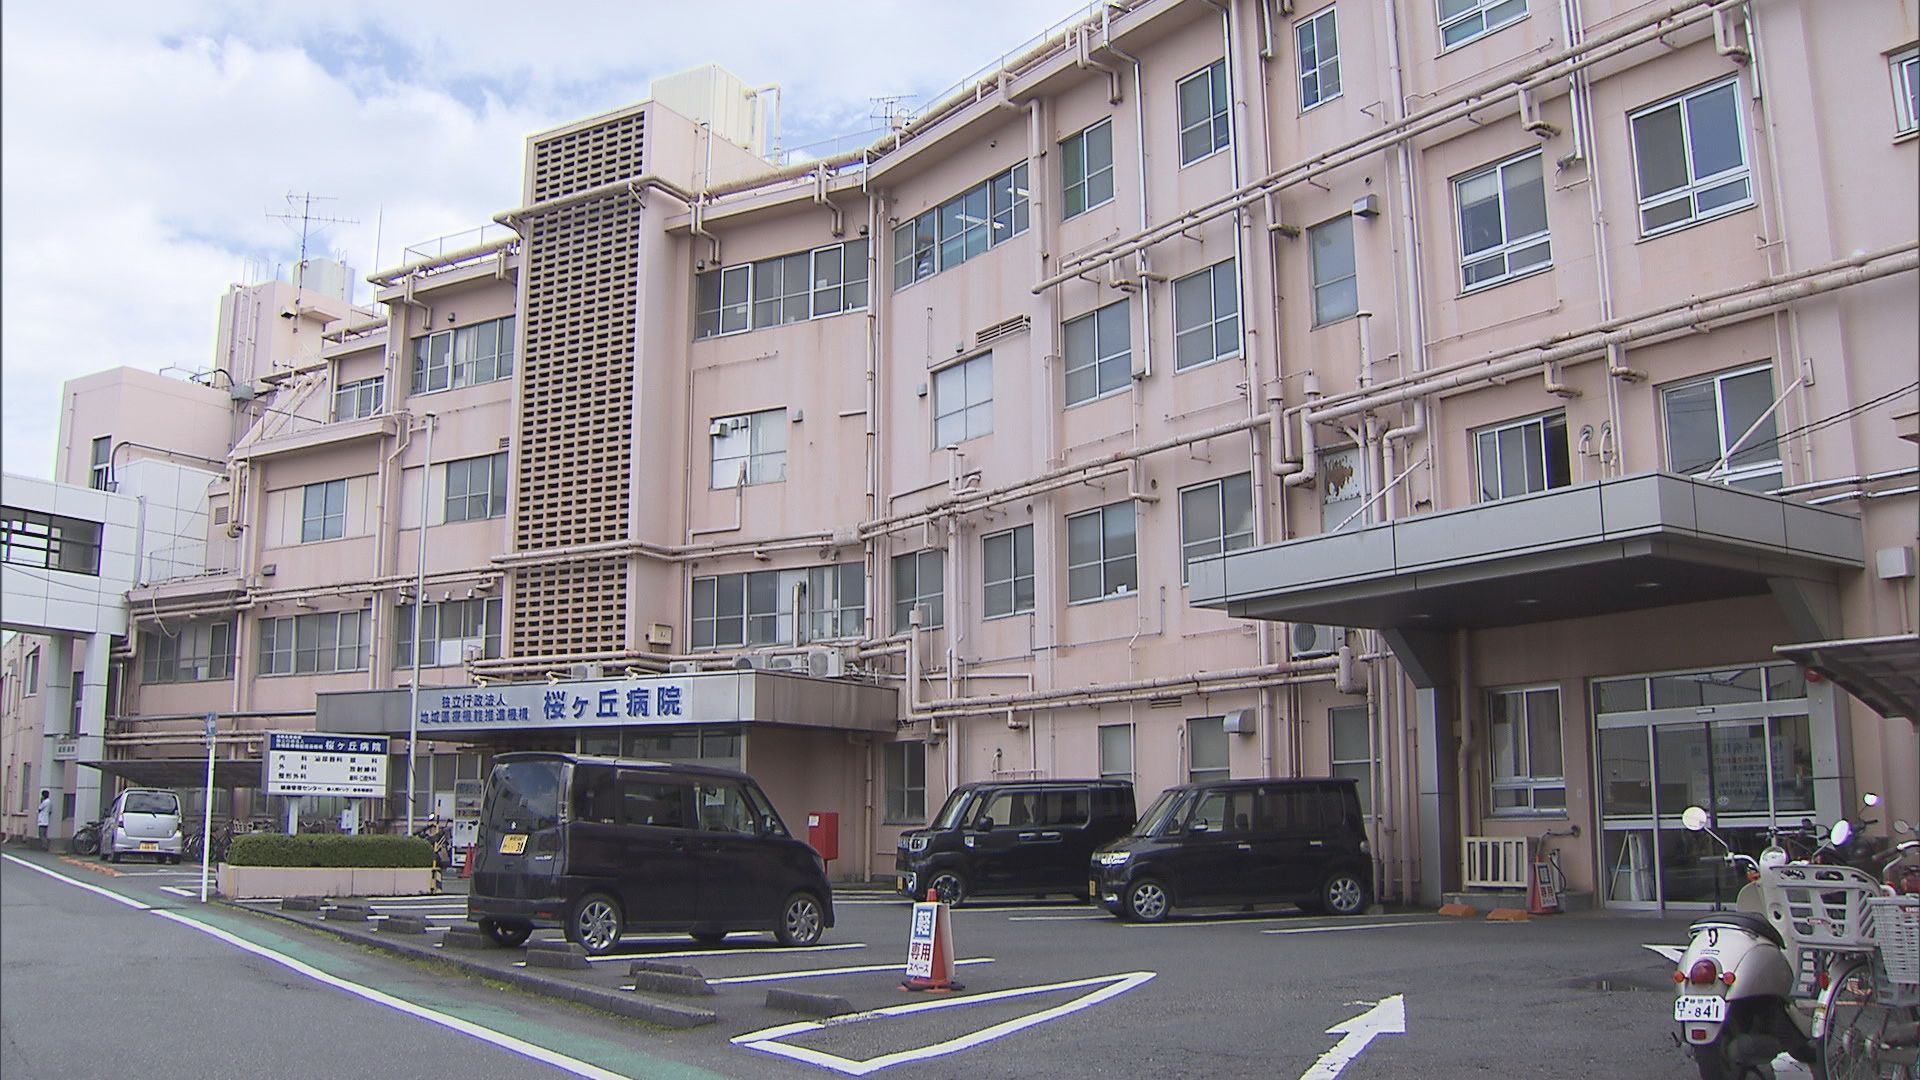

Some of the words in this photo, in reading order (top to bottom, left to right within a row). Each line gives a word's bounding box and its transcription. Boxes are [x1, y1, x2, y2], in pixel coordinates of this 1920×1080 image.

[441, 693, 507, 709] 独立行政法人
[911, 942, 931, 960] 専用
[909, 963, 929, 972] スペース
